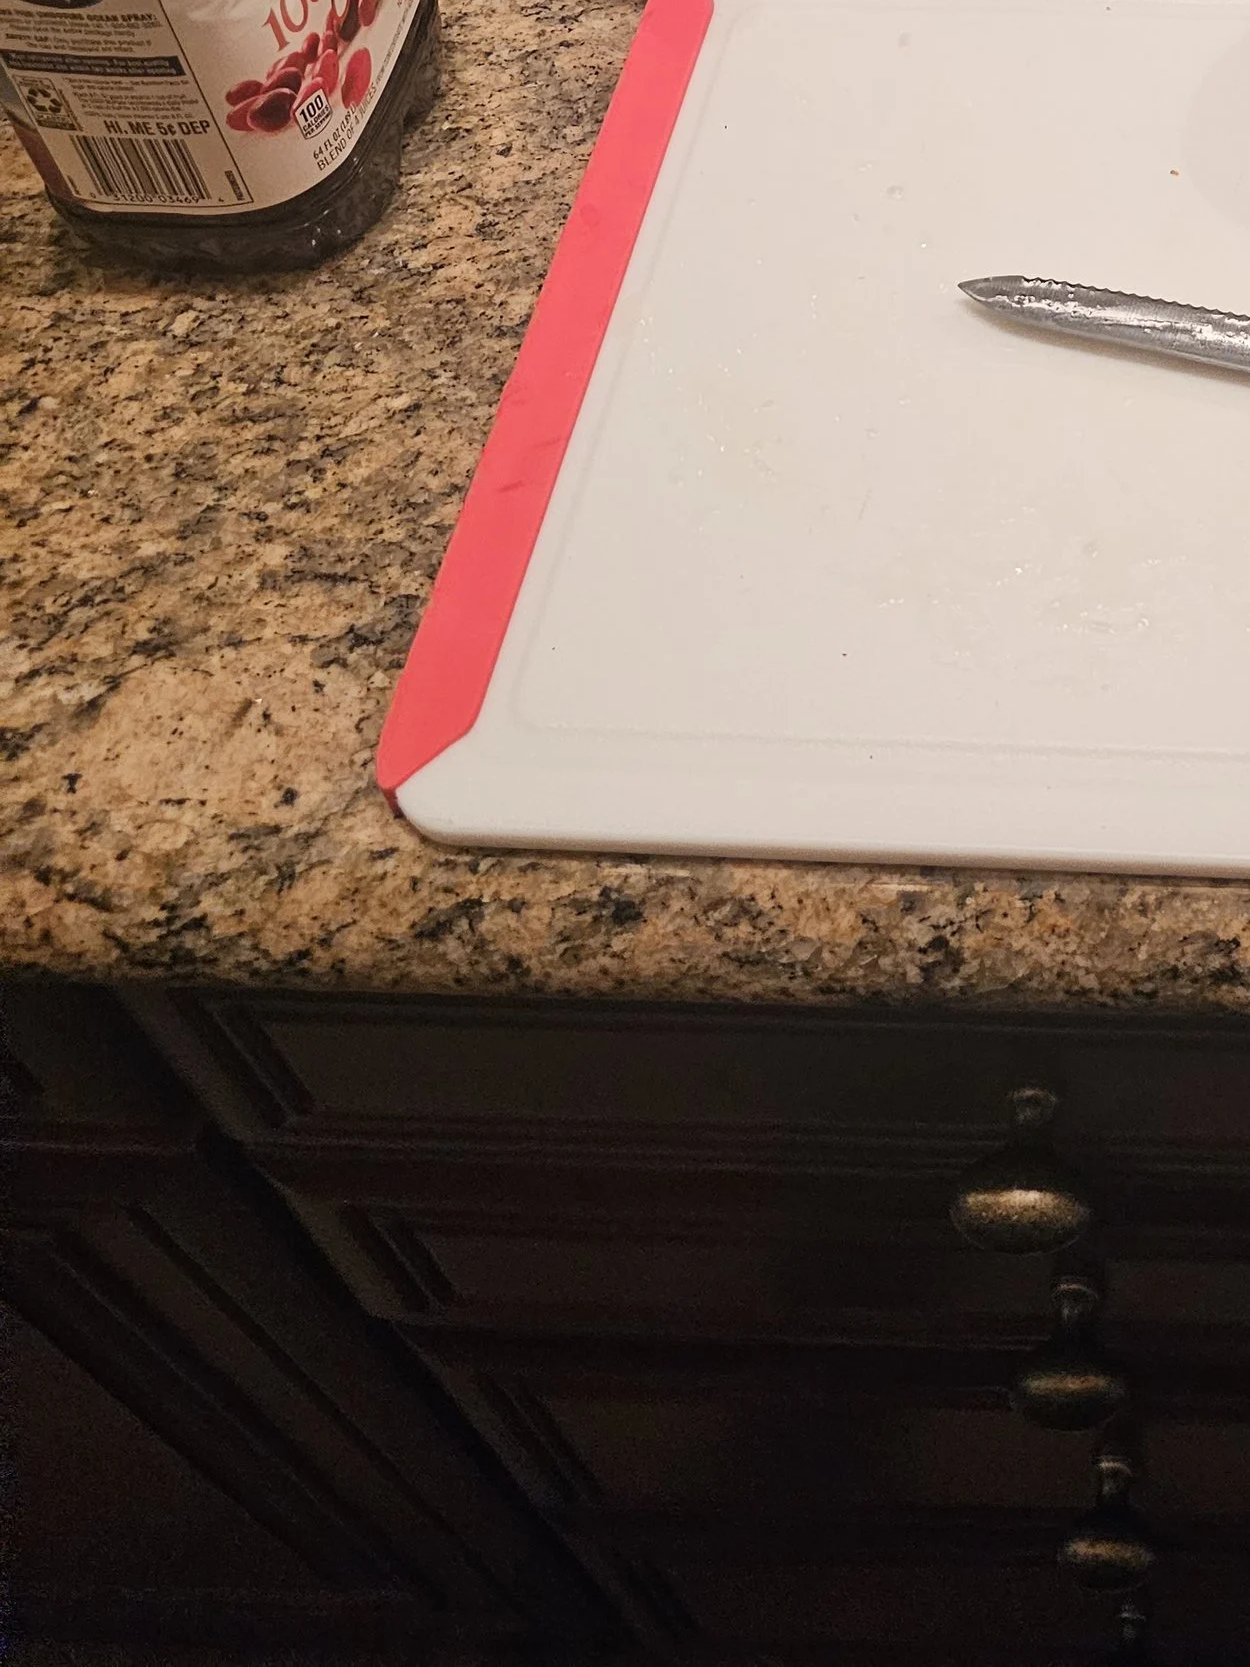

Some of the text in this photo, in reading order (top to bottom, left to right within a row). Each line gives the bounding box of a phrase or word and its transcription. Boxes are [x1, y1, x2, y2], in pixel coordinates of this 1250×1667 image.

[300, 93, 325, 123] 100
[302, 104, 330, 134] CALORIES
[104, 120, 129, 135] HI,
[129, 120, 155, 136] ME
[179, 120, 212, 136] DEP
[312, 146, 324, 161] 64
[323, 137, 334, 153] FL
[332, 127, 342, 143] OZ
[316, 137, 348, 172] BLEND
[346, 123, 356, 140] OF
